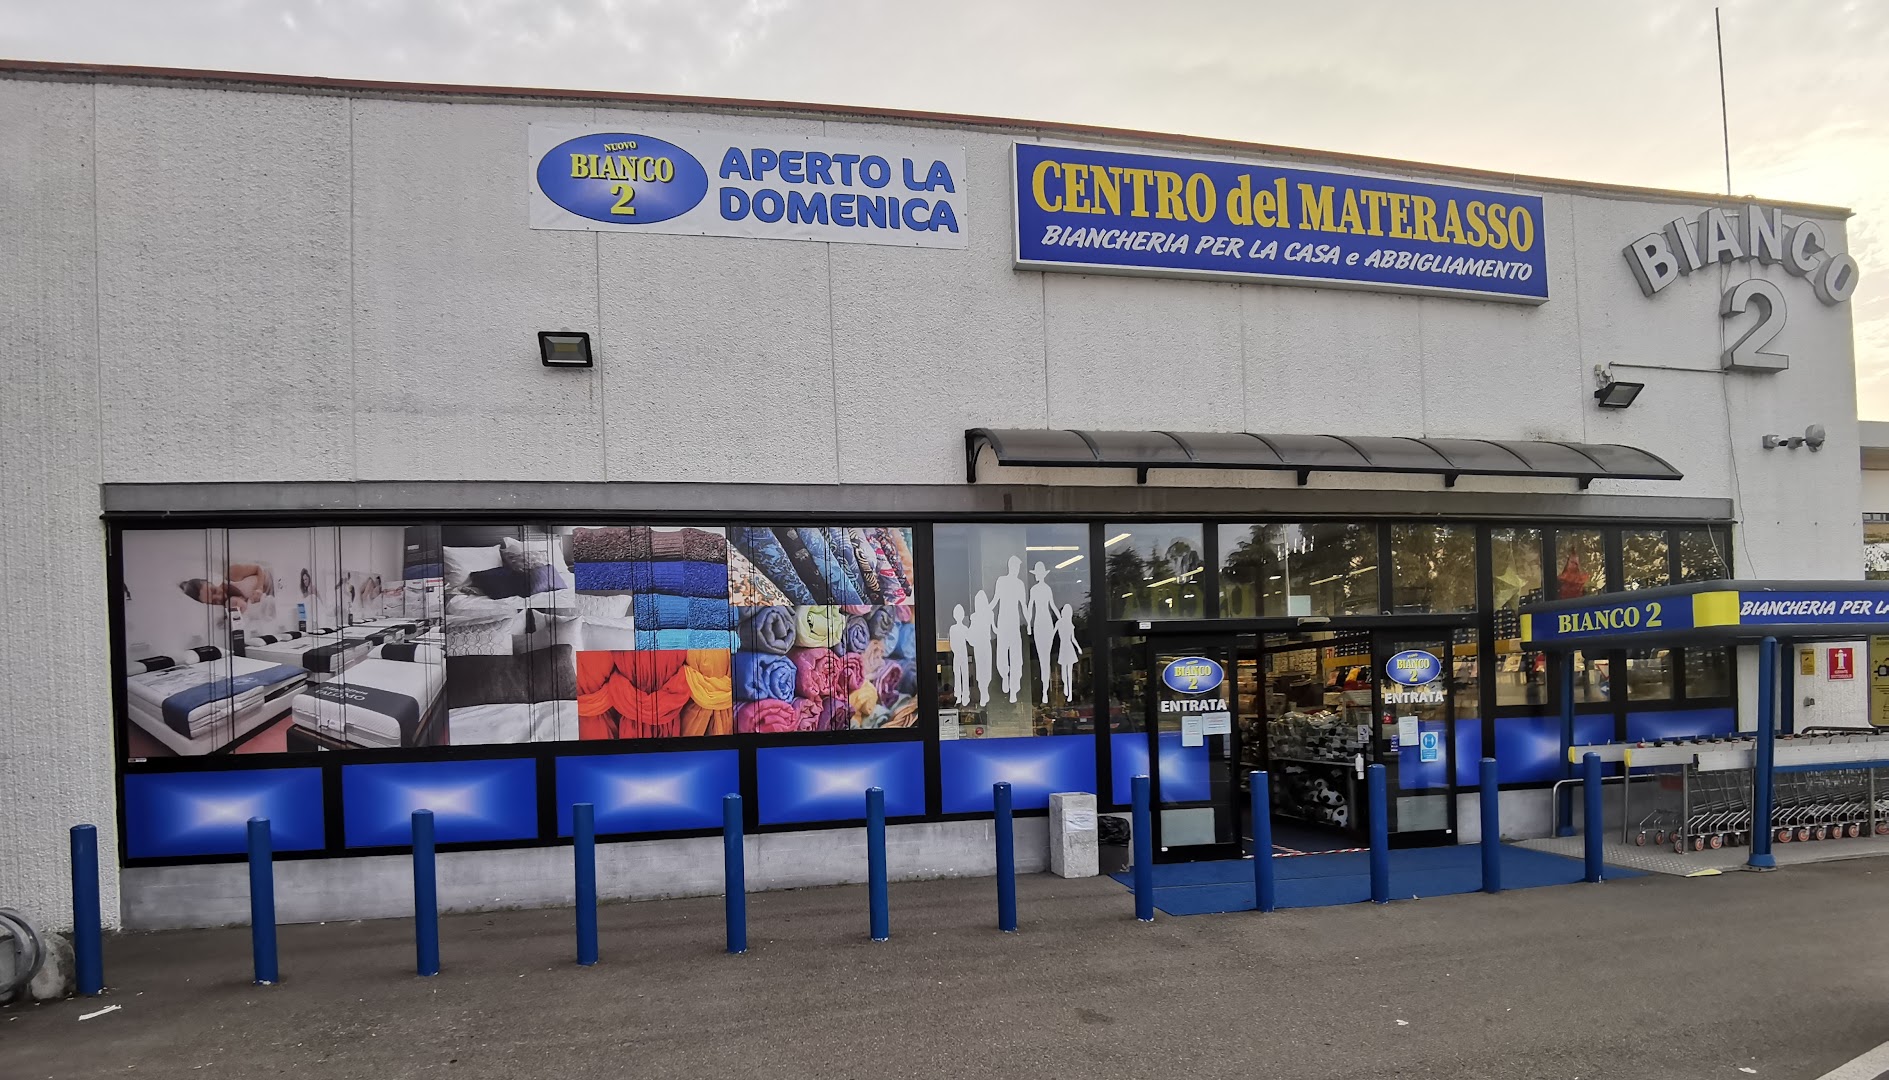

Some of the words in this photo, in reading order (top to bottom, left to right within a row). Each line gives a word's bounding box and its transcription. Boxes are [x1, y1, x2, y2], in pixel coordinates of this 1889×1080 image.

[604, 141, 638, 151] NUOVO
[570, 153, 675, 183] BIANCO
[718, 146, 892, 188] APERTO
[902, 157, 956, 193] LA
[610, 184, 636, 216] 2
[719, 187, 960, 233] DOMENICA
[1031, 160, 1218, 223] CENTRO
[1226, 174, 1289, 229] del
[1297, 183, 1534, 252] MATERASSO
[1041, 225, 1188, 255] BIANCHERIA
[1195, 236, 1242, 259] PER
[1249, 240, 1277, 262] LA
[1283, 242, 1341, 266] CASA
[1345, 252, 1357, 266] e
[1364, 249, 1533, 282] ABBIGLIAMENTO
[1623, 203, 1860, 307] BIANCO
[1719, 278, 1789, 373] 2
[1558, 607, 1640, 634] BIANCO
[1645, 602, 1662, 628] 2
[1740, 600, 1836, 616] BIANCHERIA
[1839, 600, 1873, 615] PER
[1174, 665, 1212, 677] BIANCO
[1396, 658, 1430, 670] BIANCO
[1409, 670, 1418, 682] 2
[1188, 678, 1198, 690] 2
[1384, 690, 1445, 705] ENTRATA
[1160, 699, 1228, 713] ENTRATA
